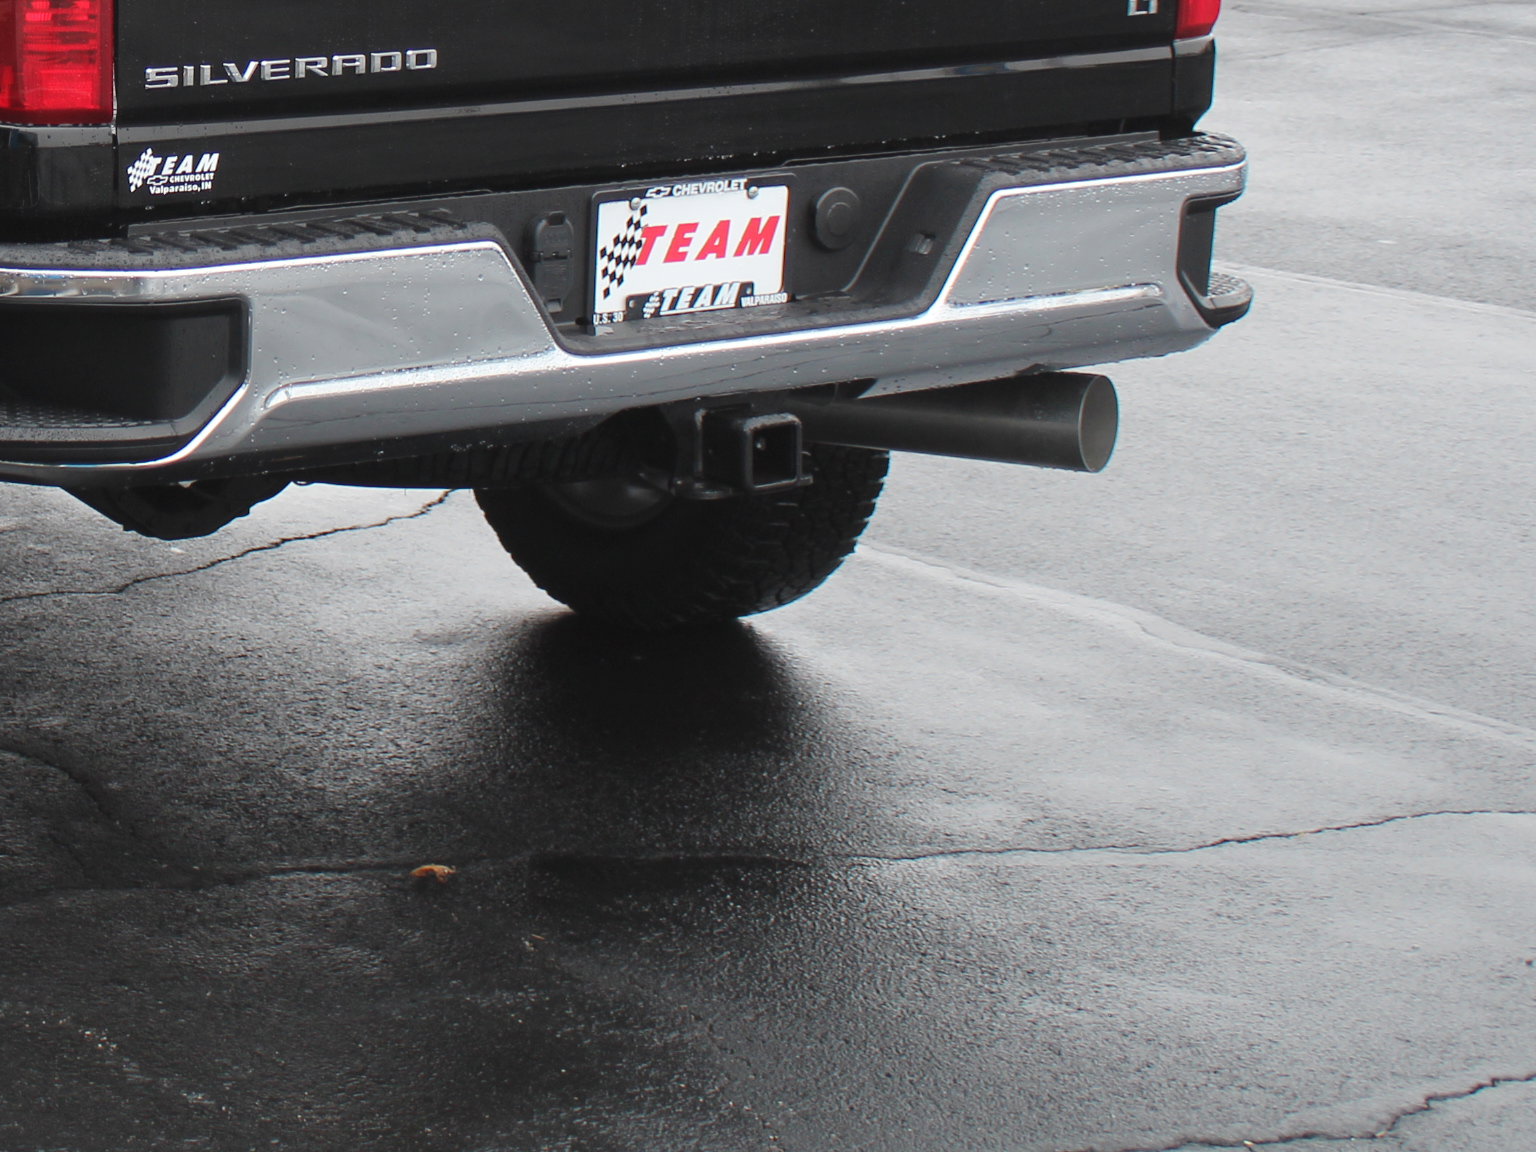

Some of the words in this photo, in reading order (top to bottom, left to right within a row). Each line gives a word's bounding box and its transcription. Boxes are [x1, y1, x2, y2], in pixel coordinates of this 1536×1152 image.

[145, 48, 438, 89] SILVERADO
[147, 152, 220, 177] TEAM
[169, 172, 215, 184] CHEVROLET
[672, 178, 748, 197] CHEVROLET
[635, 215, 781, 266] TEAM
[659, 281, 741, 313] TEAM
[741, 292, 788, 308] VALPARAISO
